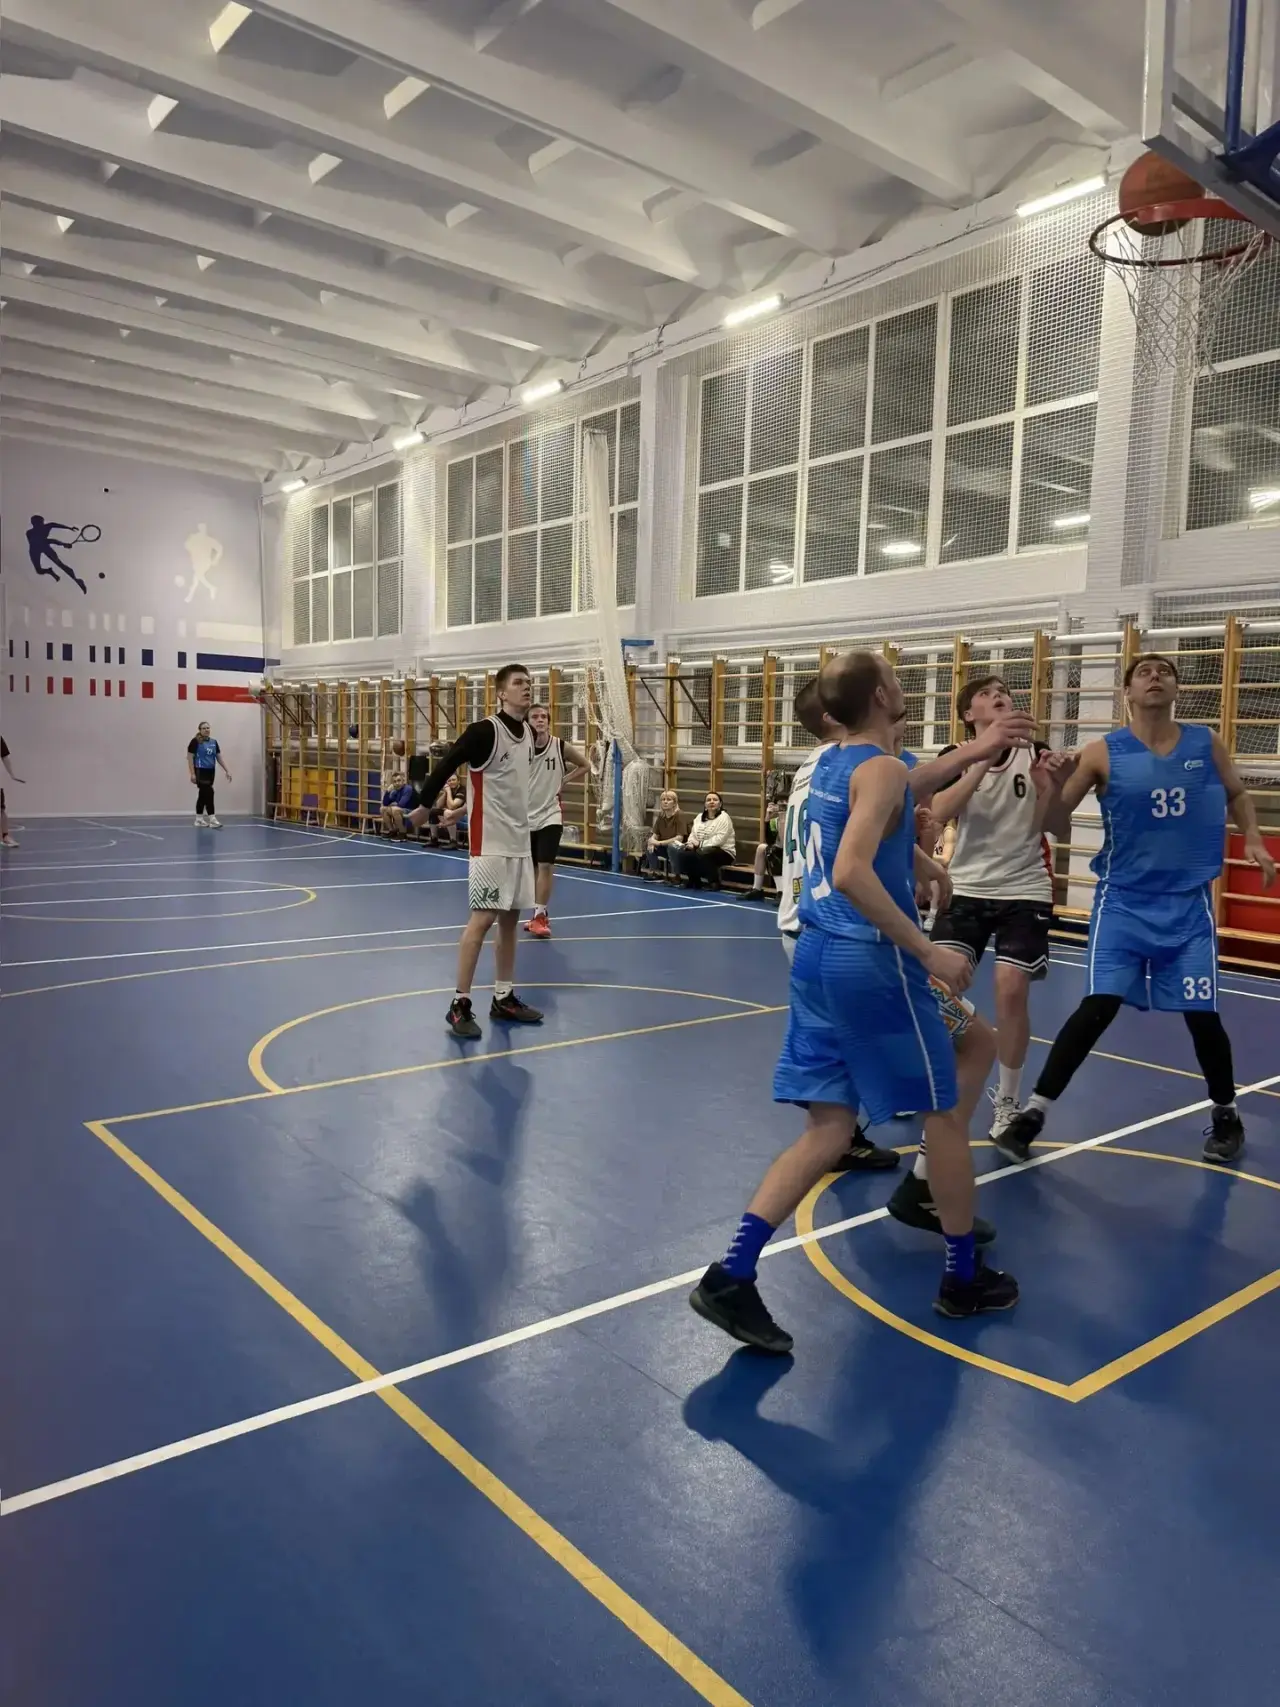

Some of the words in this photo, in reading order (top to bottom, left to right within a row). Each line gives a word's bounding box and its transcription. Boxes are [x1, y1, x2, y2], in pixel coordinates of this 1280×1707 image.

[545, 757, 555, 770] 11
[1014, 773, 1026, 798] 6
[1151, 787, 1186, 818] 33
[481, 887, 500, 902] 14
[1182, 976, 1212, 1000] 33
